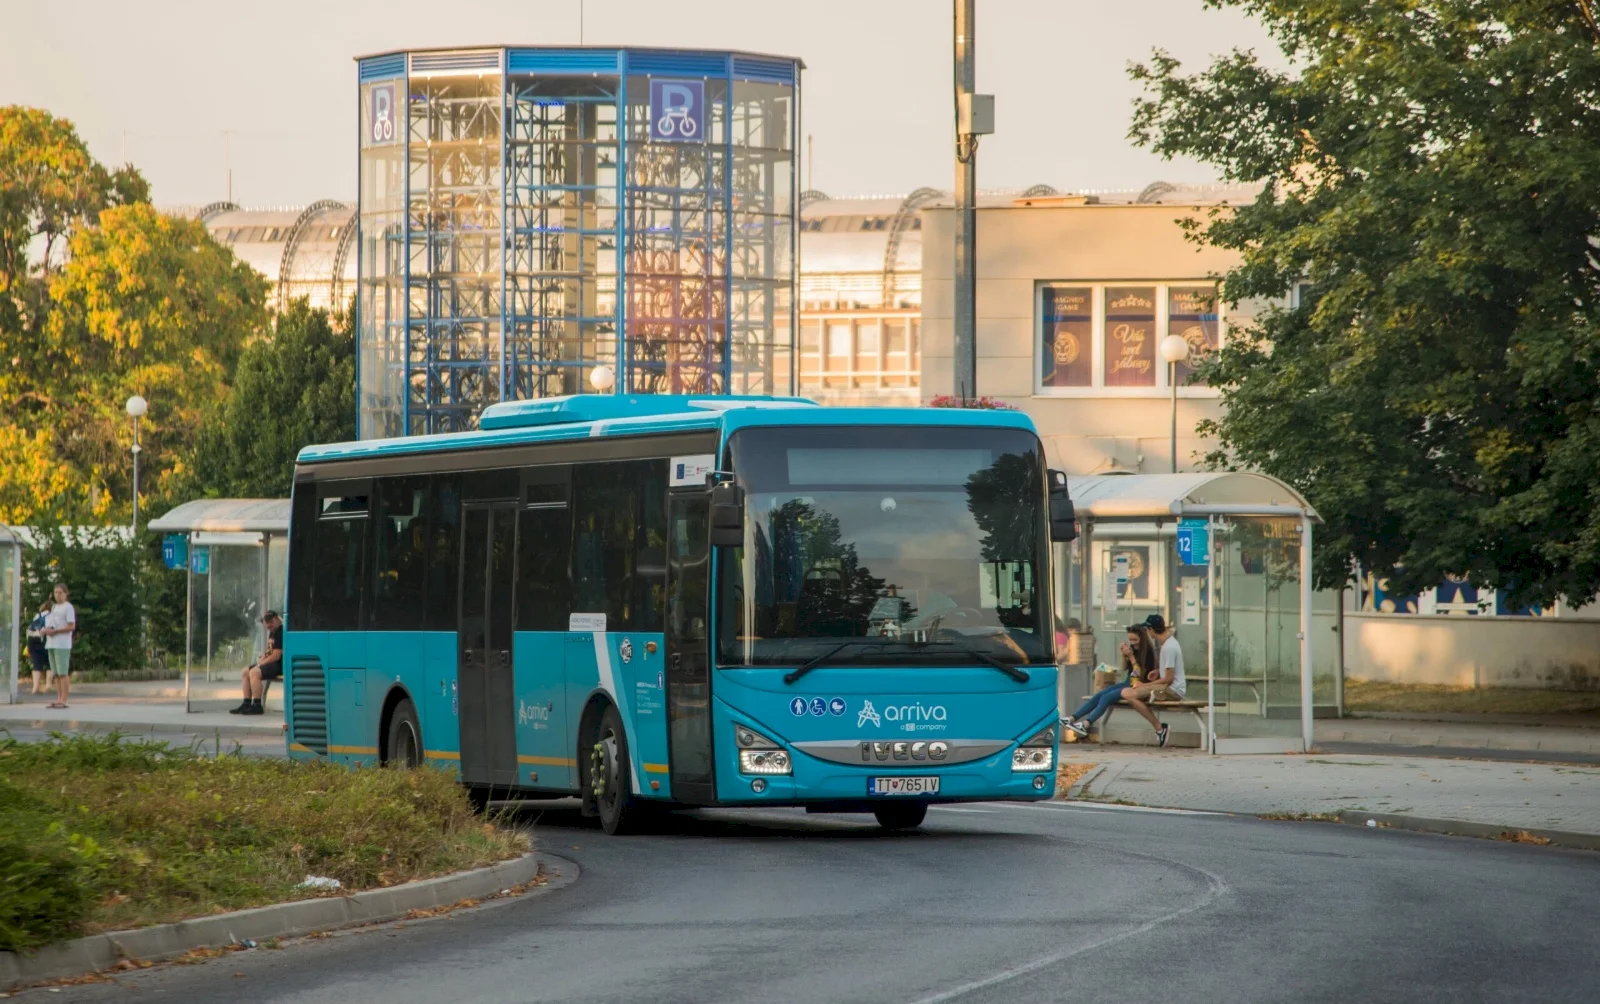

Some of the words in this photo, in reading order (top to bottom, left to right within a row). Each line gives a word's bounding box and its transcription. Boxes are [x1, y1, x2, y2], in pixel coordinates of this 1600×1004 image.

[375, 89, 390, 119] P
[662, 84, 694, 118] P
[164, 548, 173, 559] 11
[1178, 537, 1191, 552] 12
[884, 701, 947, 721] arriva
[861, 741, 948, 761] IVECO
[877, 779, 892, 792] TT
